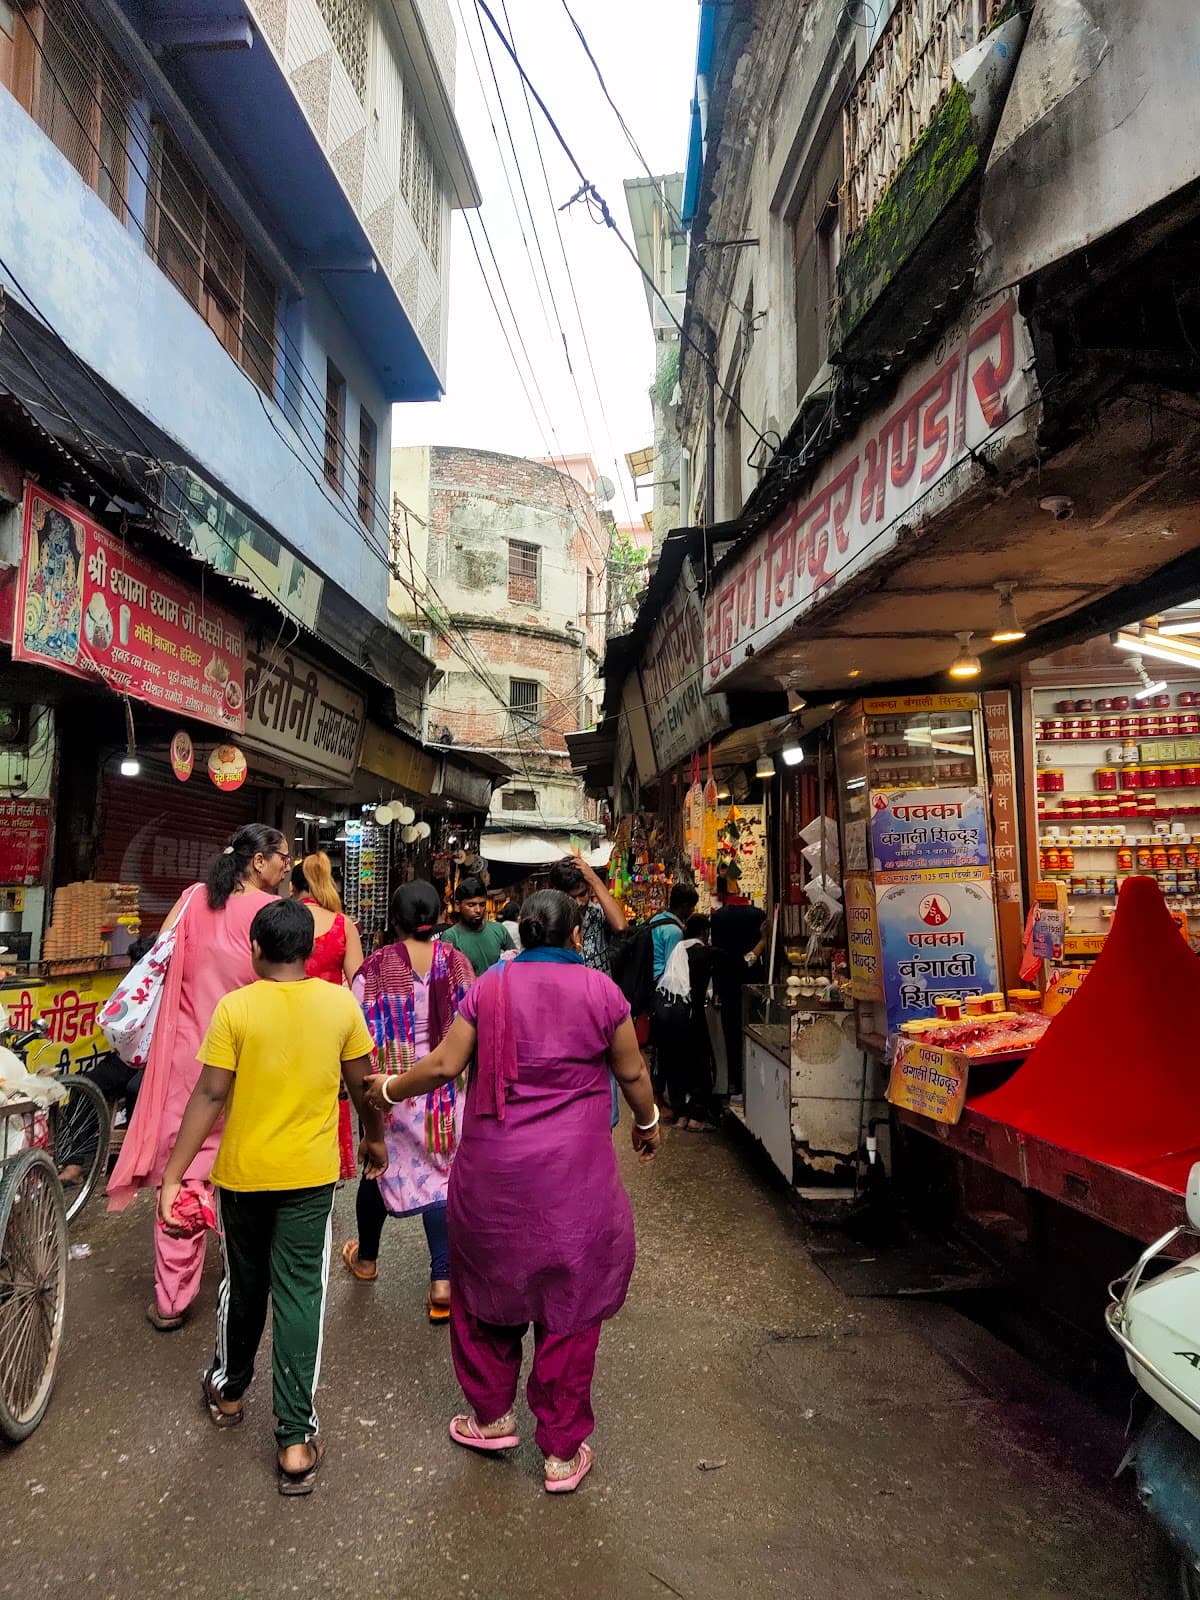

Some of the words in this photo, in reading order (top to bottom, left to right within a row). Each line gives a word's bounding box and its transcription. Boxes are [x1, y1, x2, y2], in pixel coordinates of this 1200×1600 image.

[705, 556, 760, 678] सुहाग
[762, 455, 860, 618] सिन्दूर
[88, 546, 107, 588] श्री
[150, 590, 180, 626] श्याम
[181, 601, 196, 634] जी
[985, 704, 1006, 718] पक्का
[997, 794, 1009, 811] में
[892, 803, 962, 821] पक्का
[931, 827, 979, 845] सिन्दूर
[999, 821, 1008, 834] न
[908, 932, 964, 947] पक्का
[898, 954, 976, 977] बंगाली
[7, 991, 33, 1031] जी
[40, 990, 98, 1043] पंडित
[919, 1048, 943, 1066] पक्का
[928, 1067, 959, 1096] सिन्दूर
